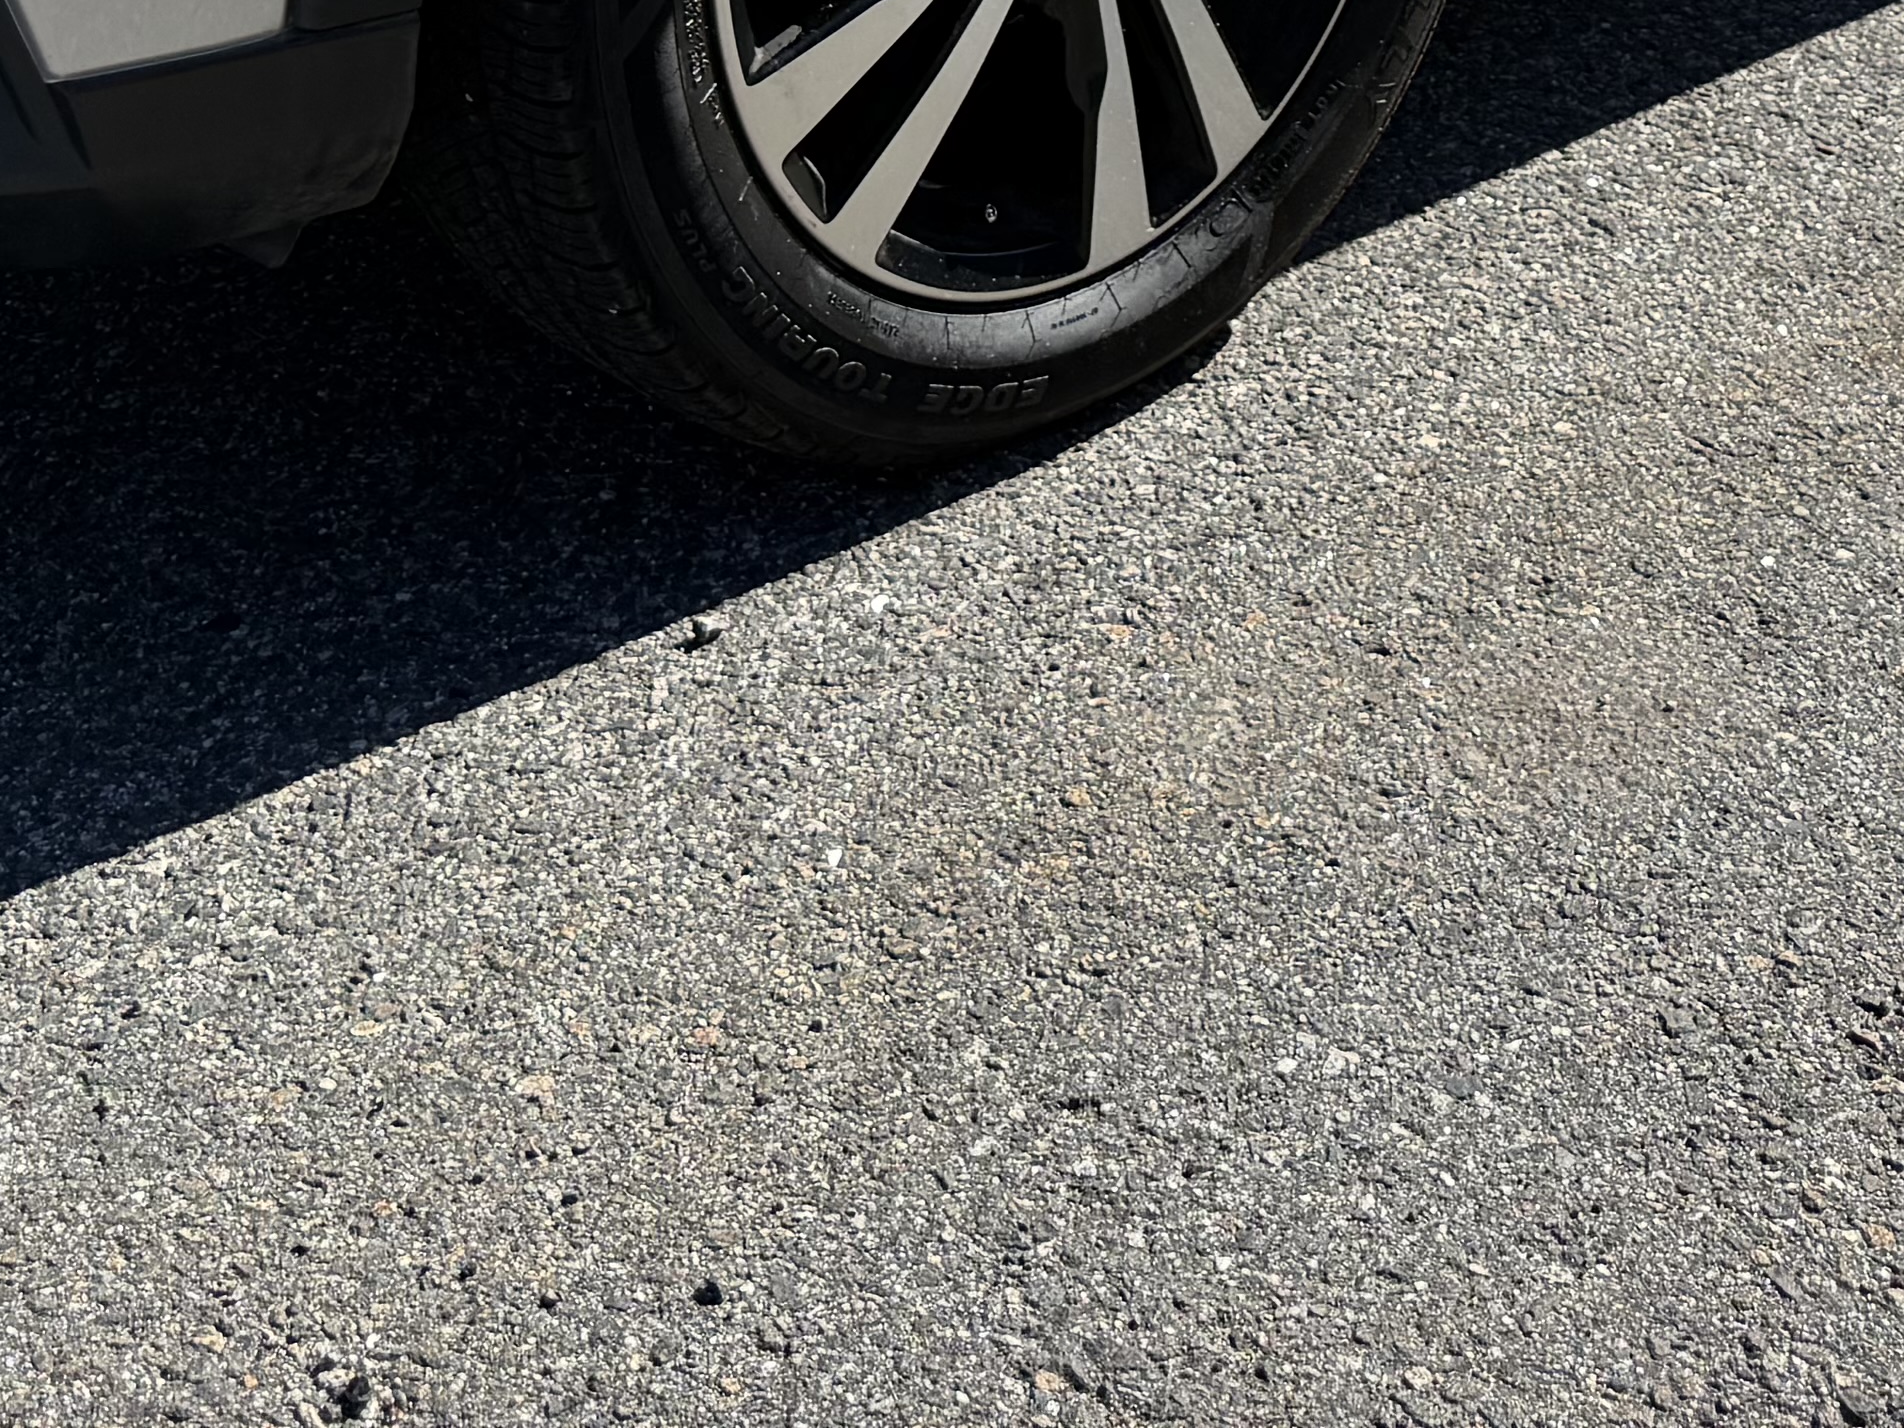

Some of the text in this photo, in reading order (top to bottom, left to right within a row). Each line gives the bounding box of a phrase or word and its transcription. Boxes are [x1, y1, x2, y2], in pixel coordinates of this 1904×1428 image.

[673, 209, 718, 274] PLUS
[722, 265, 893, 404] TOURING
[917, 374, 1050, 416] EDGE
